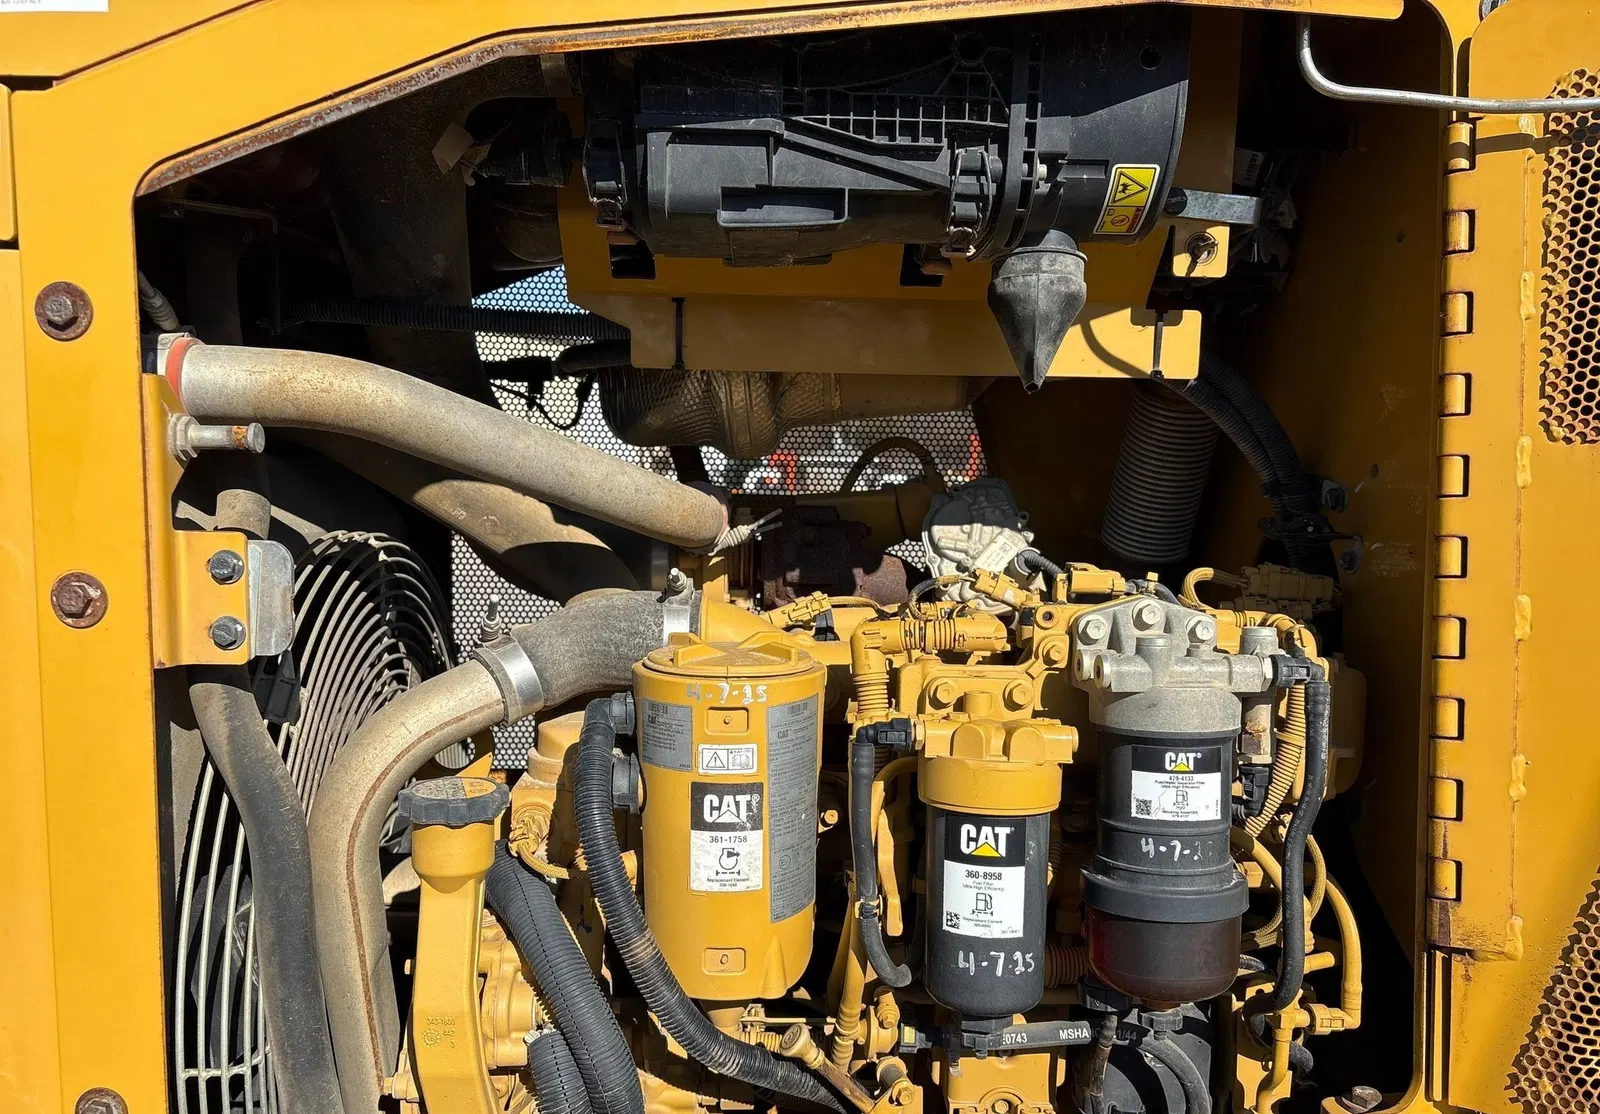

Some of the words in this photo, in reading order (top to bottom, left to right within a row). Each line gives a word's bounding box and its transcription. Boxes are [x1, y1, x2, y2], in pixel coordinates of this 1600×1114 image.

[709, 835, 748, 844] 361-1758
[965, 869, 1003, 881] 360-8958
[1059, 1028, 1090, 1040] MSHA
